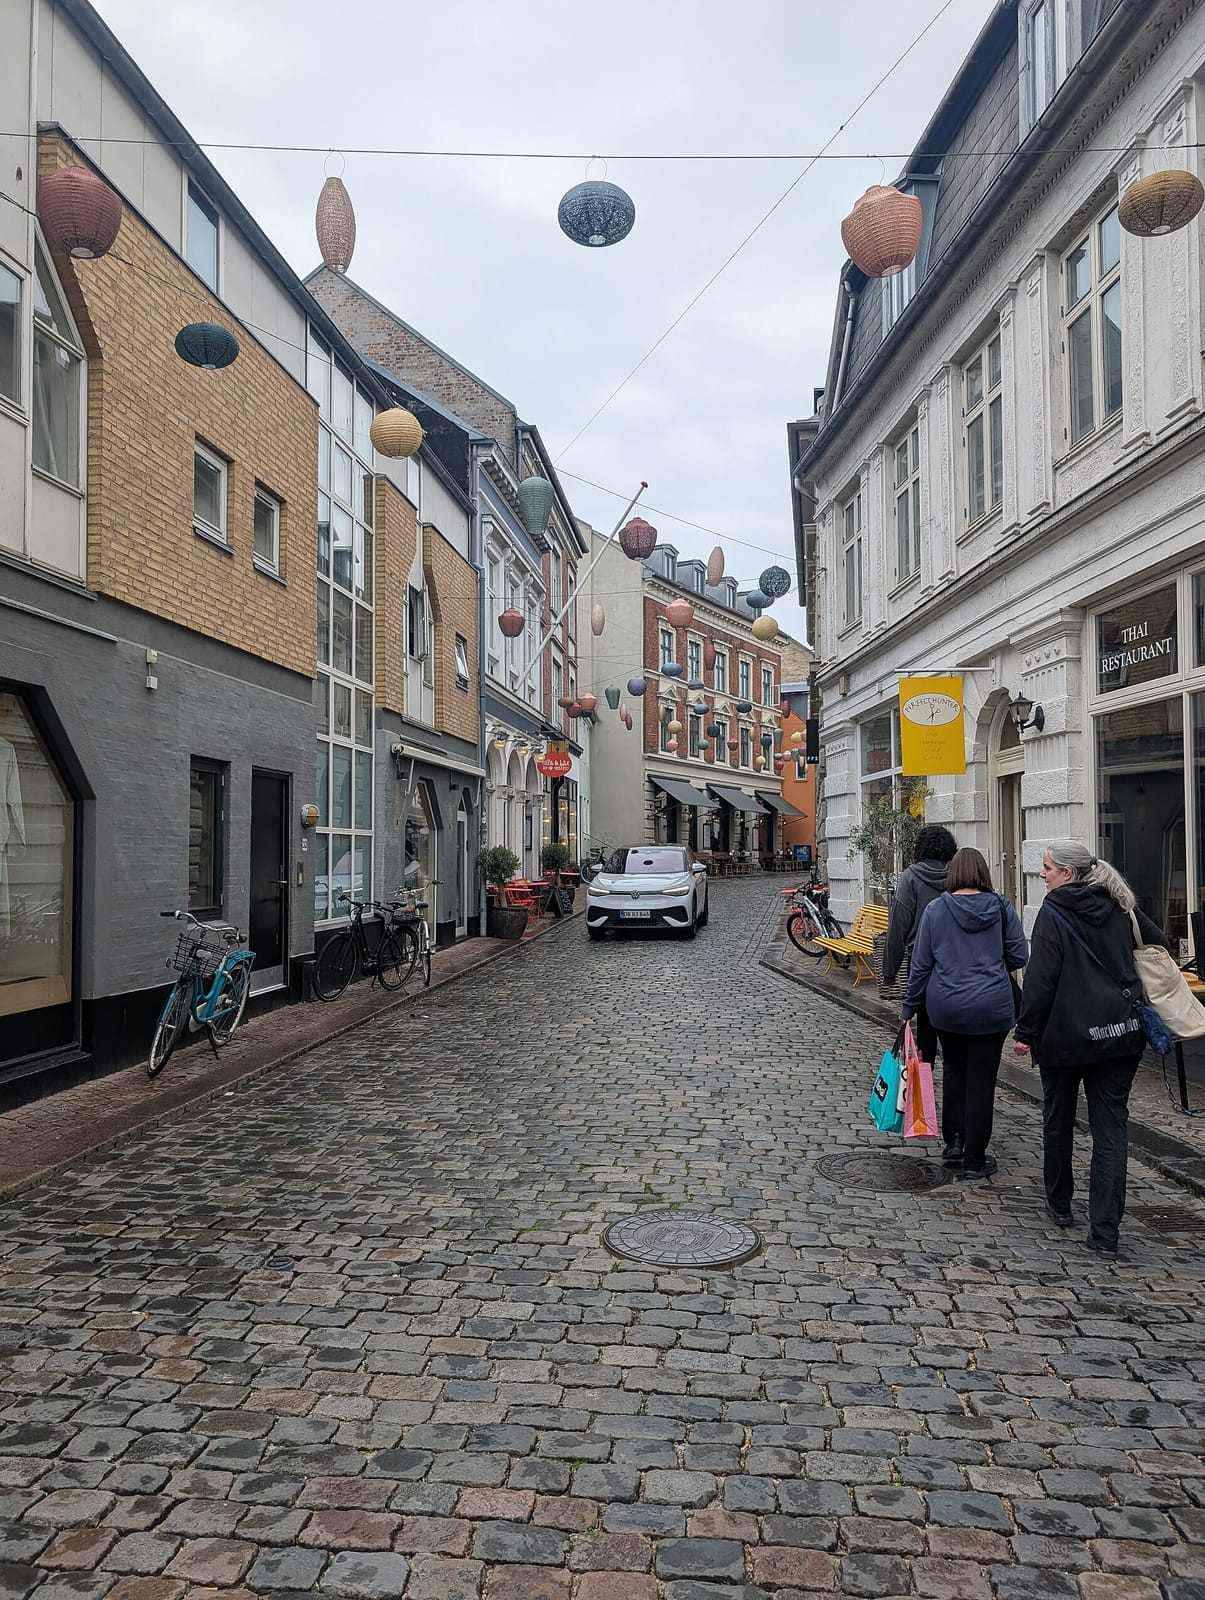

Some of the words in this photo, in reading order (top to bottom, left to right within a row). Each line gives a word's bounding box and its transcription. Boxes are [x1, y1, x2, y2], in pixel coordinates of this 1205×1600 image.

[1121, 621, 1149, 644] THAI
[1102, 637, 1173, 673] RESTAURANT
[905, 697, 931, 713] PERFECT
[932, 697, 958, 712] HUNTER
[1089, 1022, 1127, 1041] Marilyn
